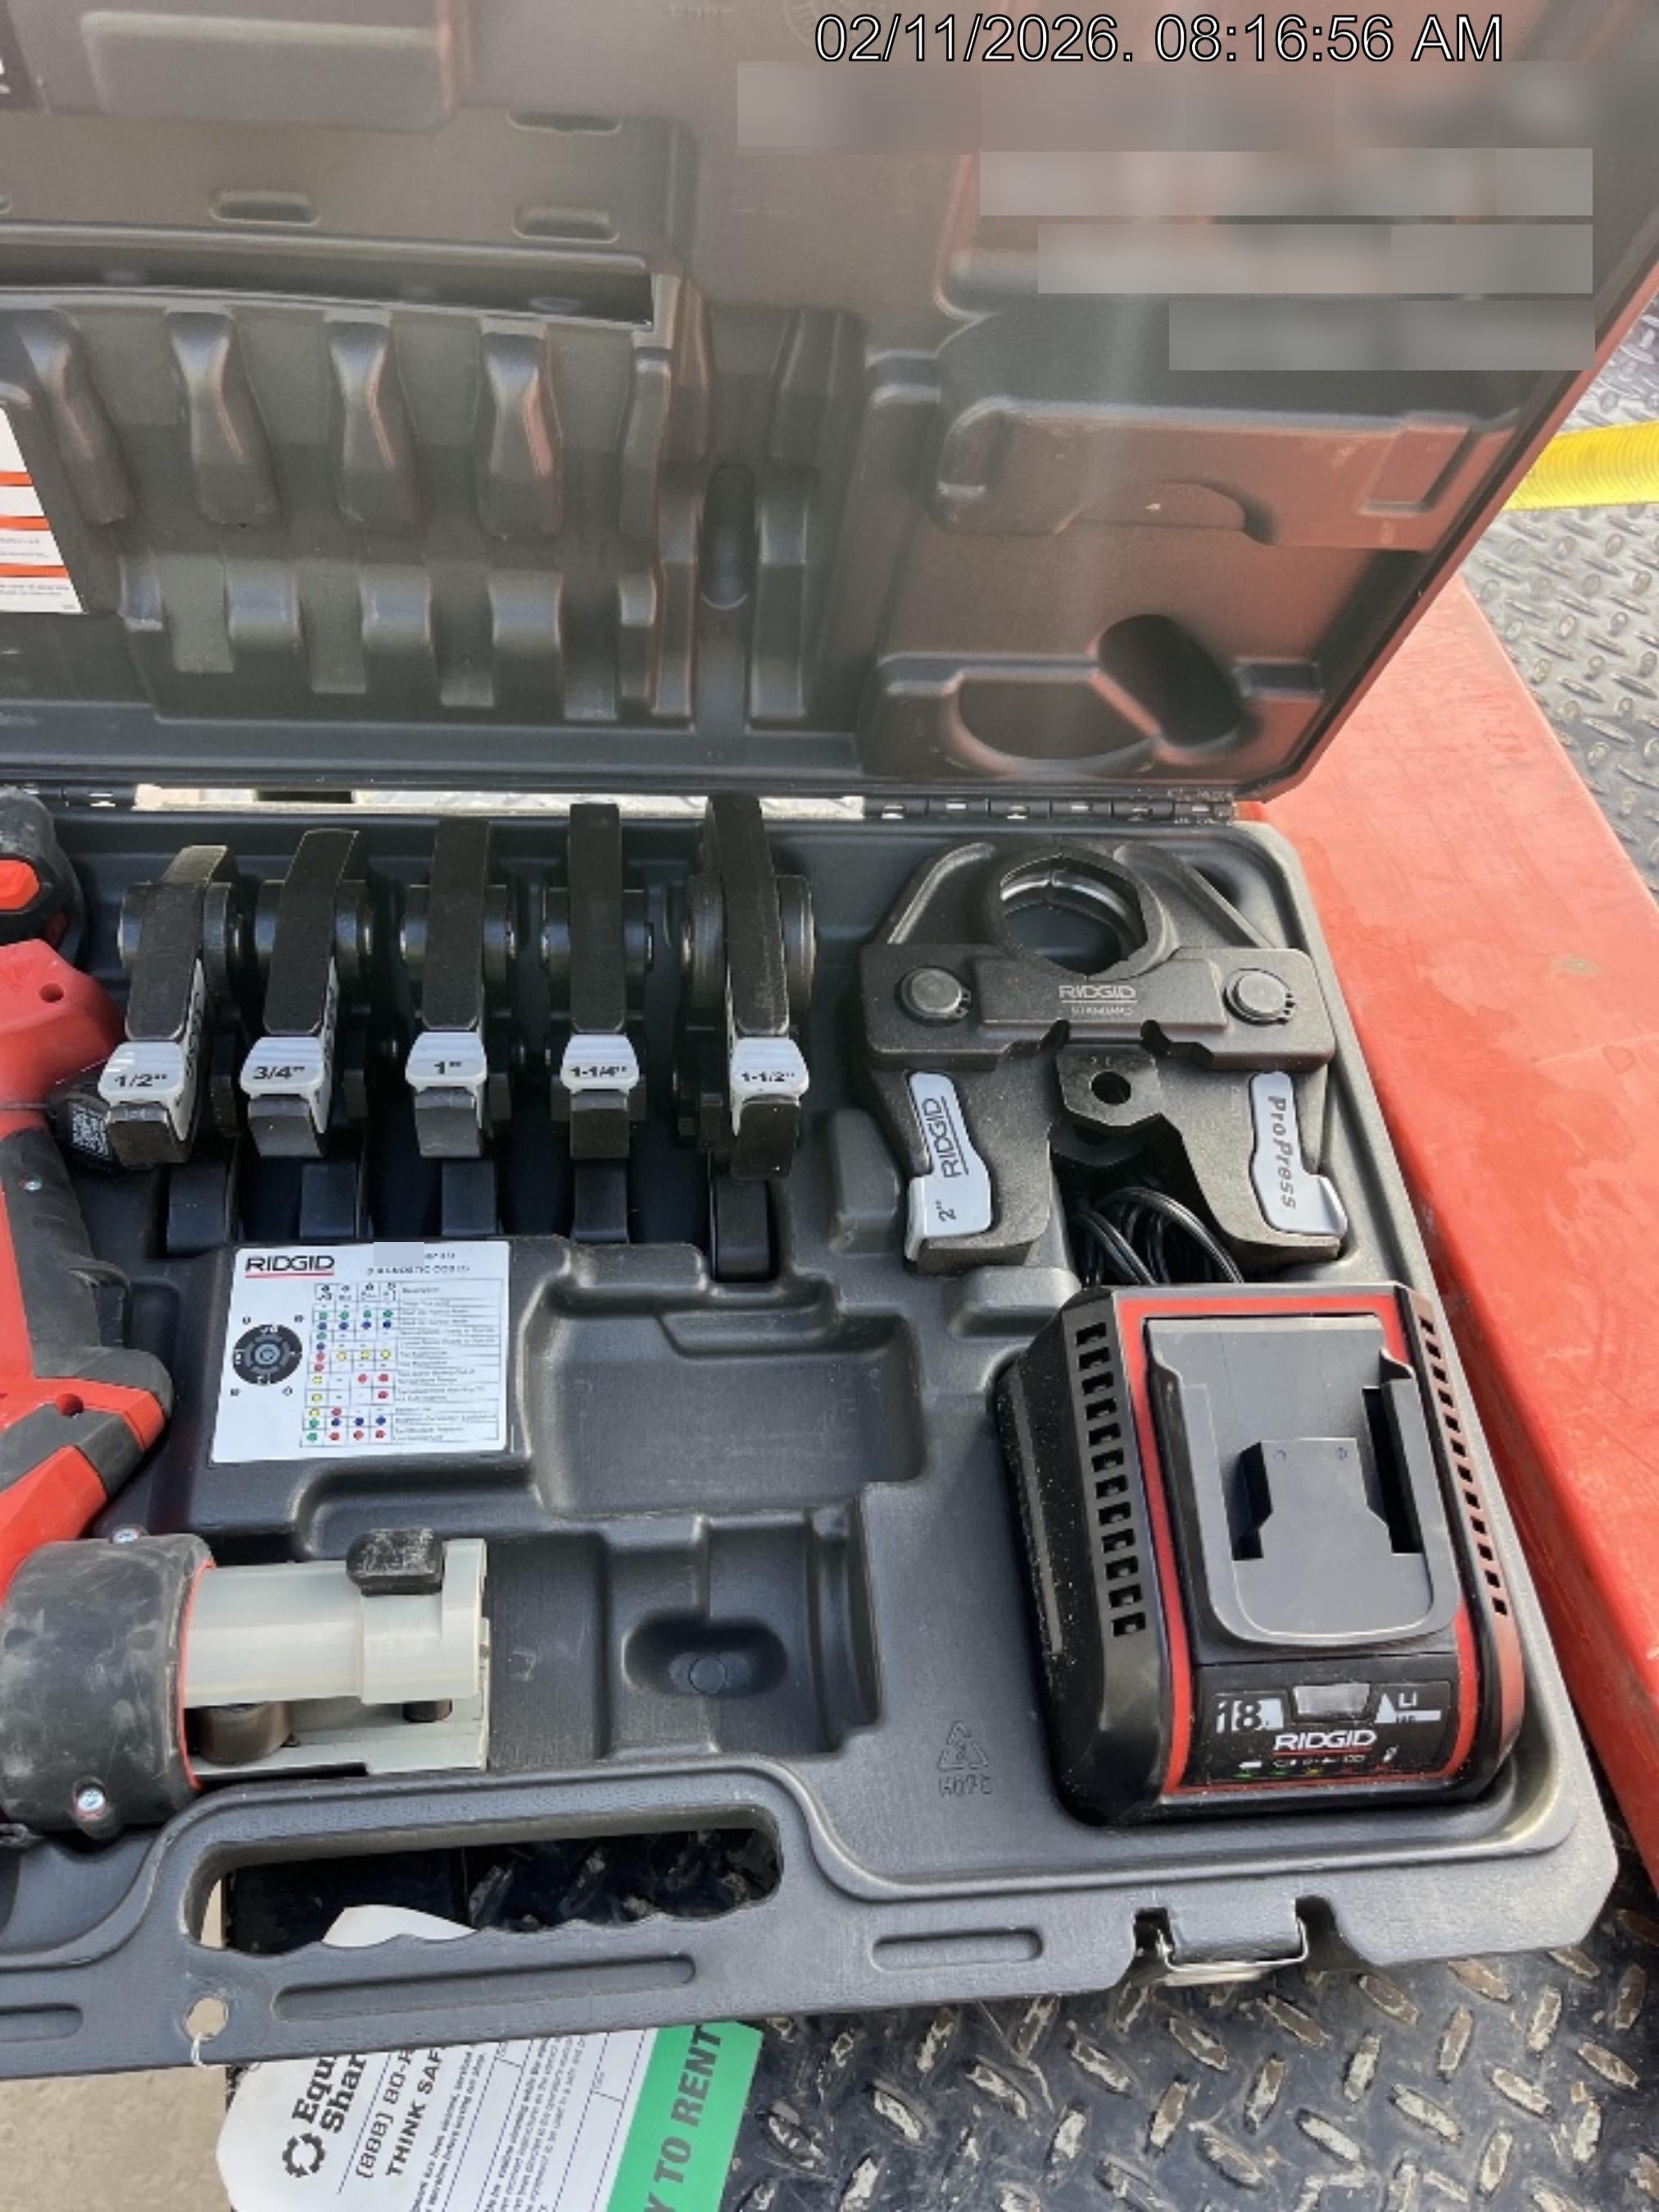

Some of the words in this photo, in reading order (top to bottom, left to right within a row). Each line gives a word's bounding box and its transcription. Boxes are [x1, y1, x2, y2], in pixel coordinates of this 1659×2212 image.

[1058, 985, 1136, 999] RIDGID
[252, 1066, 305, 1081] 3/4"
[433, 1061, 462, 1075] 1"
[569, 1067, 628, 1078] 1-1/4"
[115, 1073, 168, 1088] 1/2"
[922, 1098, 963, 1178] RIDGID
[936, 1200, 956, 1222] 2"
[246, 1254, 335, 1271] RIDGID
[1272, 1729, 1378, 1751] RIDGID
[670, 2024, 722, 2128] RENT
[385, 2098, 427, 2176] THINK
[654, 2135, 692, 2183] TO
